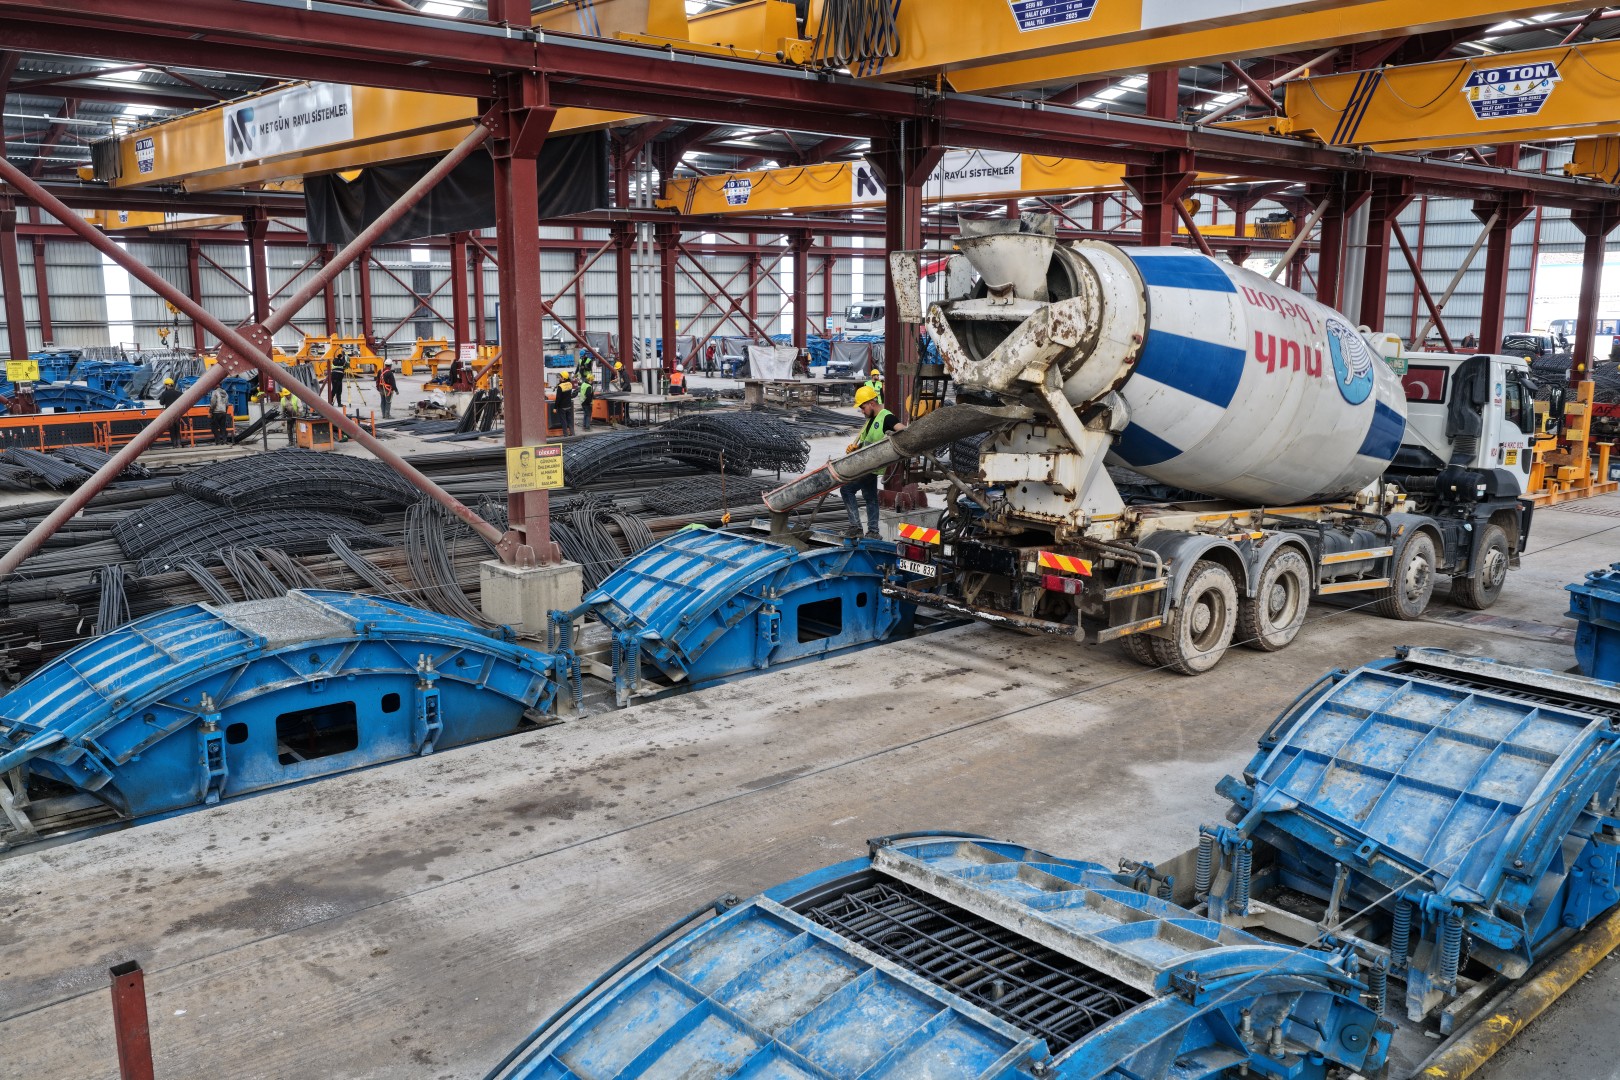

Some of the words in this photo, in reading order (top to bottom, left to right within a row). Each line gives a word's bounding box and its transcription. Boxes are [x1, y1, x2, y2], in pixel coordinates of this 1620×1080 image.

[1475, 71, 1500, 84] 10
[1506, 65, 1550, 81] TON
[260, 115, 290, 135] METGÜN
[292, 113, 311, 128] RAYLI
[143, 139, 153, 149] TON
[944, 169, 967, 180] RAYLI
[900, 560, 906, 569] 34
[910, 562, 920, 572] KKC
[923, 566, 935, 576] 832
